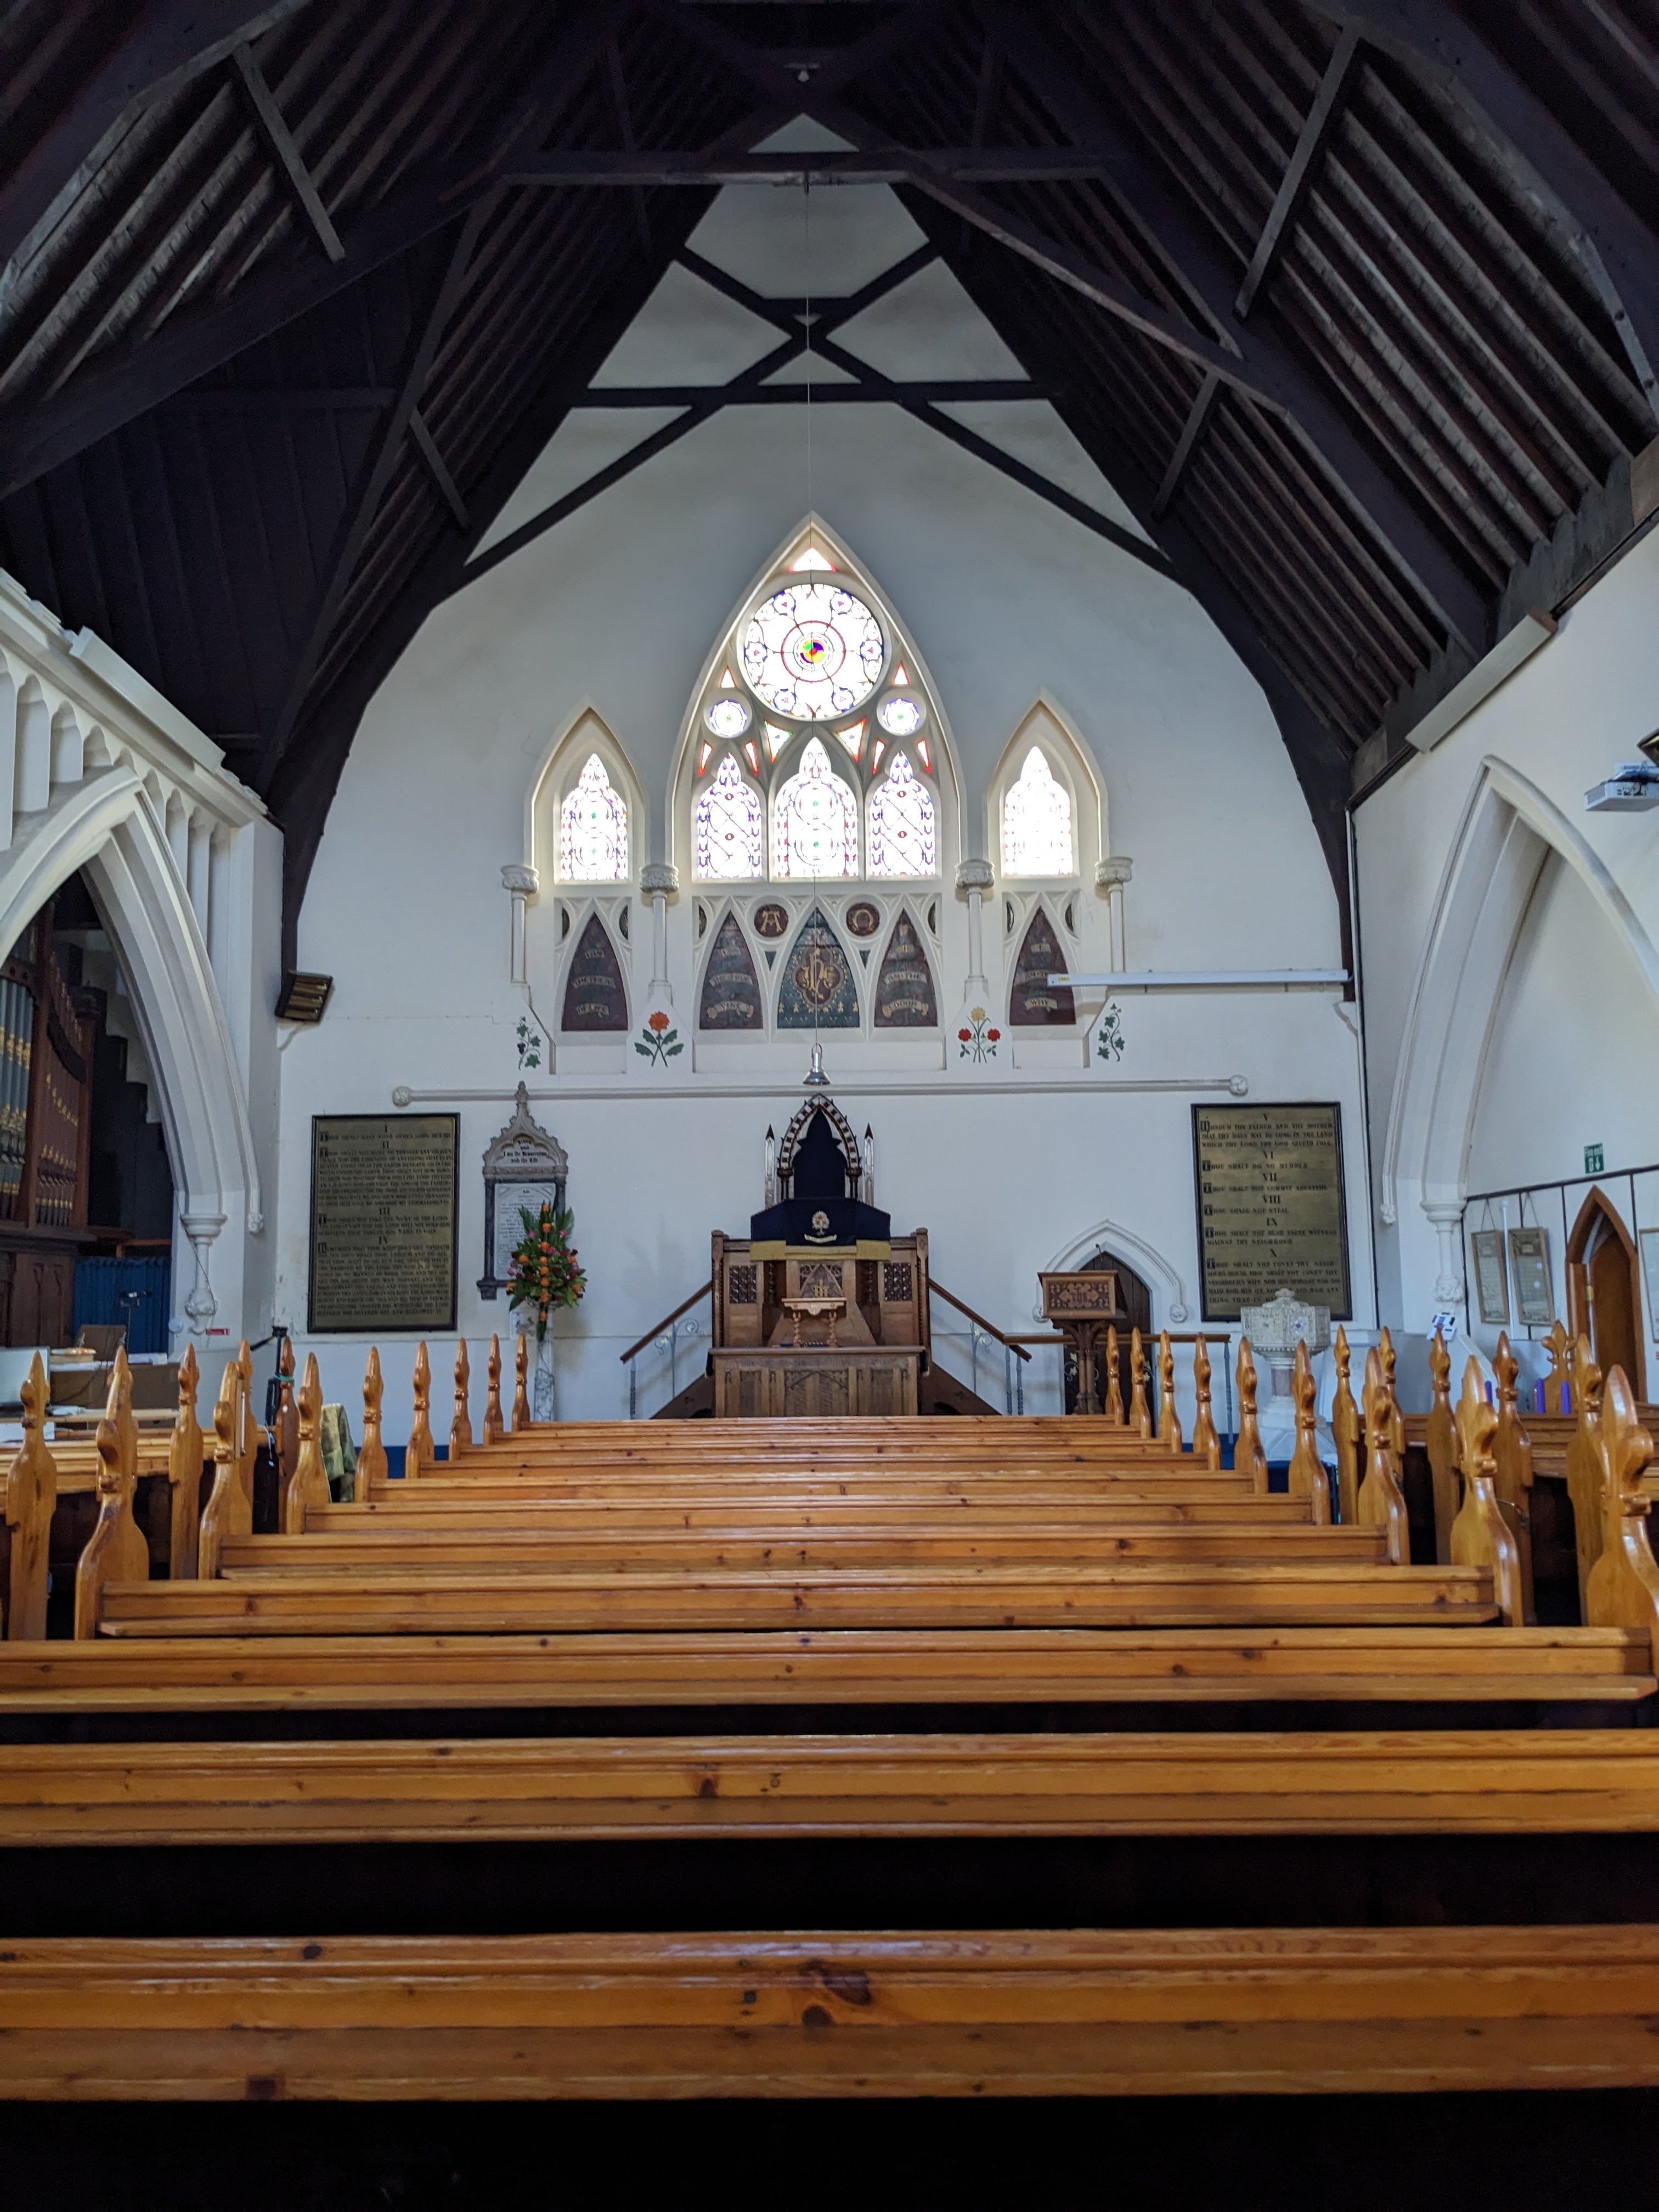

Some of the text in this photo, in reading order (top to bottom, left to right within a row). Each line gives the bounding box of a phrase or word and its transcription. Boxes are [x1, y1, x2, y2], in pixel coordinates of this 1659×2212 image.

[1263, 1113, 1268, 1121] V
[384, 1124, 388, 1132] I
[1263, 1151, 1273, 1159] VI
[1262, 1173, 1277, 1182] VII
[1263, 1195, 1281, 1204] VIII
[379, 1207, 390, 1215] III
[1267, 1217, 1278, 1226] IX
[379, 1236, 387, 1244] IV
[1269, 1249, 1277, 1257] X
